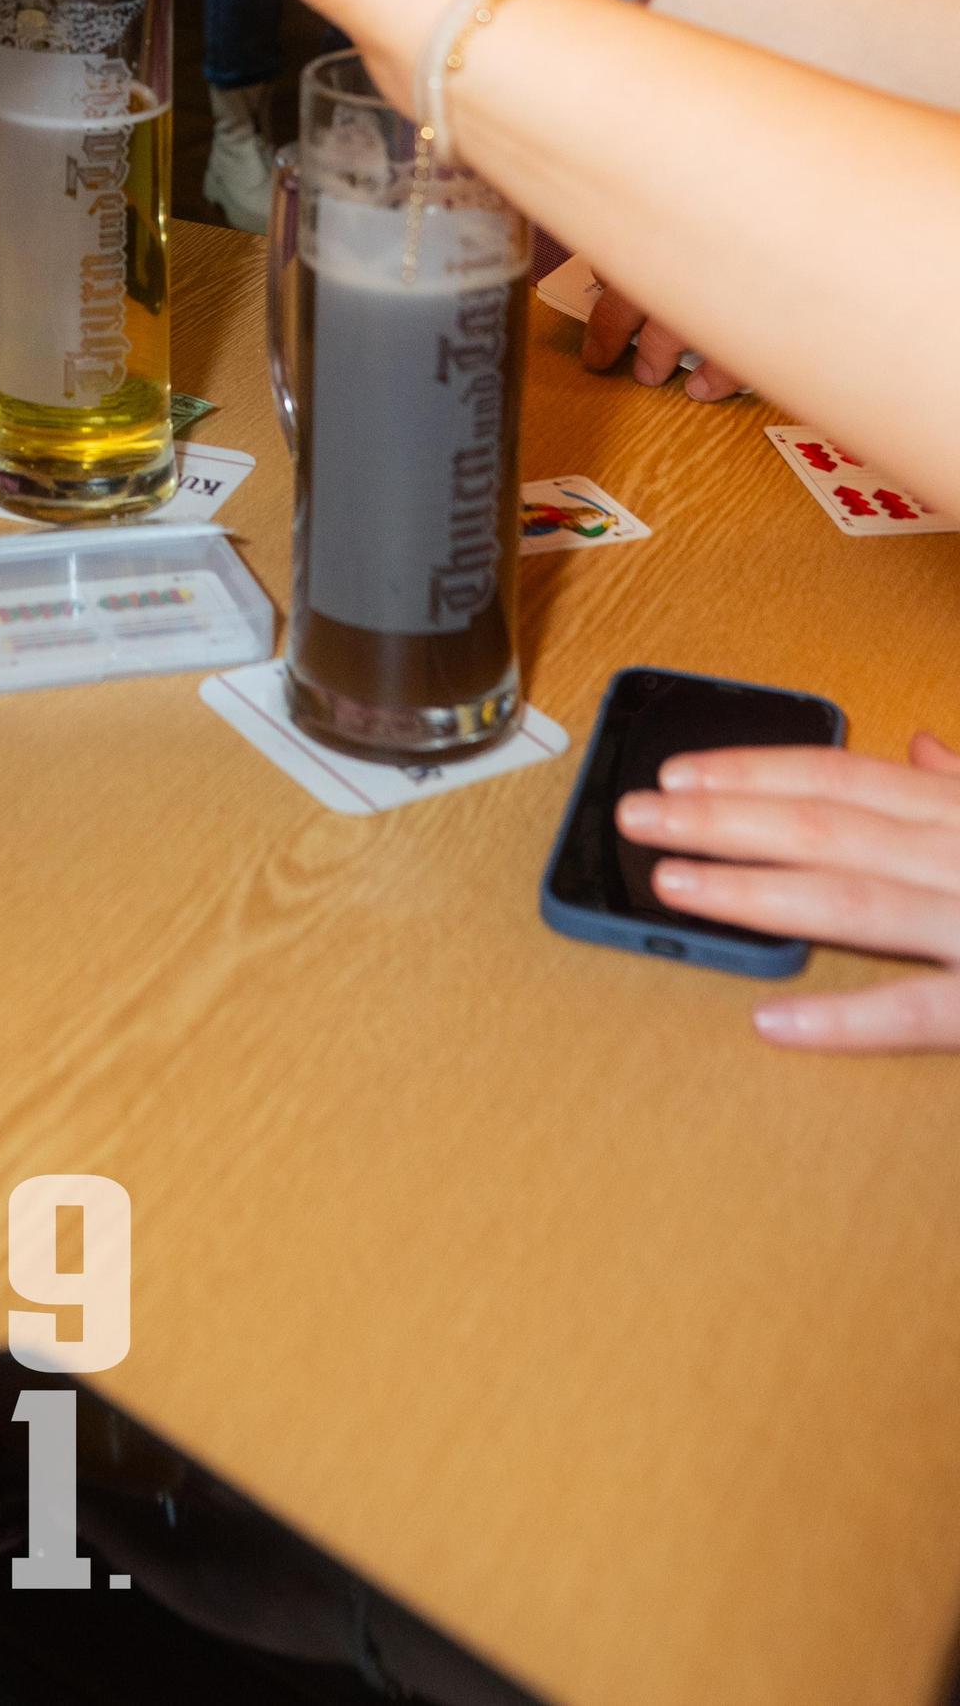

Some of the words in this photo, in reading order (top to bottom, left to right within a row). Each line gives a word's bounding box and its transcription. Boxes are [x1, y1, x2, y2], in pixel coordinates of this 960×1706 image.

[88, 190, 125, 251] und
[63, 254, 126, 398] Thurn
[429, 447, 497, 627] Thurn
